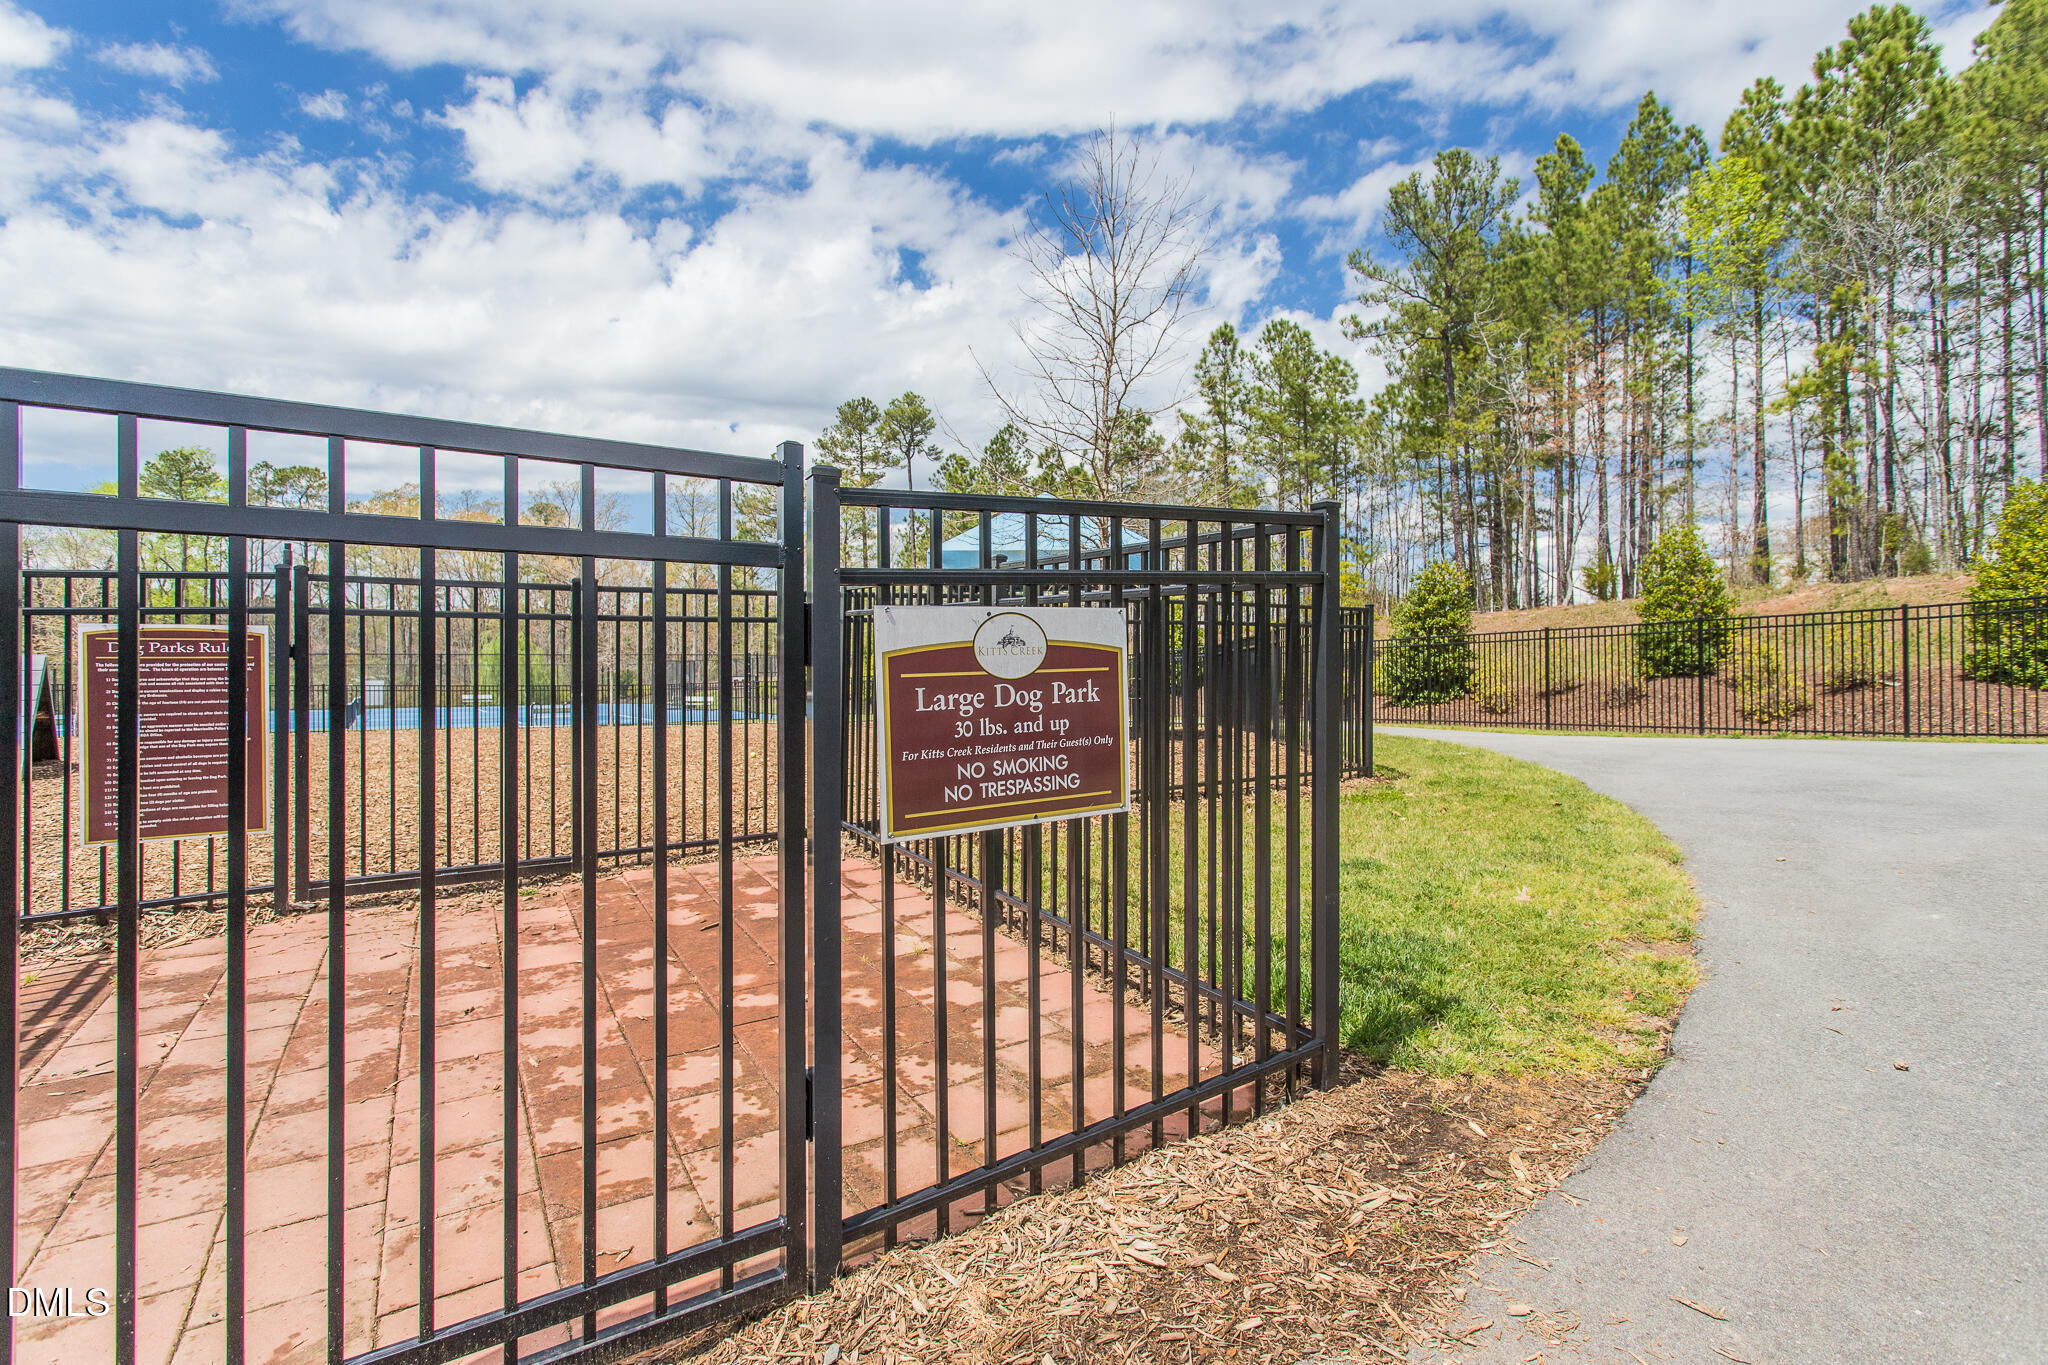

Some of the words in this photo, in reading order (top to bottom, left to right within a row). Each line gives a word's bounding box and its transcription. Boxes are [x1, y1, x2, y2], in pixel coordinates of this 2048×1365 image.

[107, 641, 144, 656] Dg
[149, 641, 194, 654] Parks
[977, 646, 1008, 656] KITTS
[1010, 646, 1043, 656] CREEK
[915, 687, 985, 716] Large
[994, 683, 1043, 712] Dog
[1052, 679, 1100, 704] Park
[954, 720, 973, 738] 30
[980, 718, 1007, 736] lbs.
[1014, 715, 1043, 734] and
[1050, 718, 1069, 735] up
[902, 751, 918, 762] For
[921, 749, 944, 760] Kitts
[947, 746, 972, 758] Creek
[974, 743, 1016, 756] Residents
[1019, 742, 1034, 751] and
[1036, 739, 1057, 750] Their
[1059, 737, 1092, 748] Guest(s)
[1094, 735, 1113, 747] Only
[957, 762, 985, 780] NO
[993, 754, 1068, 777] SMOKING
[944, 784, 973, 803] NO
[979, 773, 1080, 798] TRESPASSING
